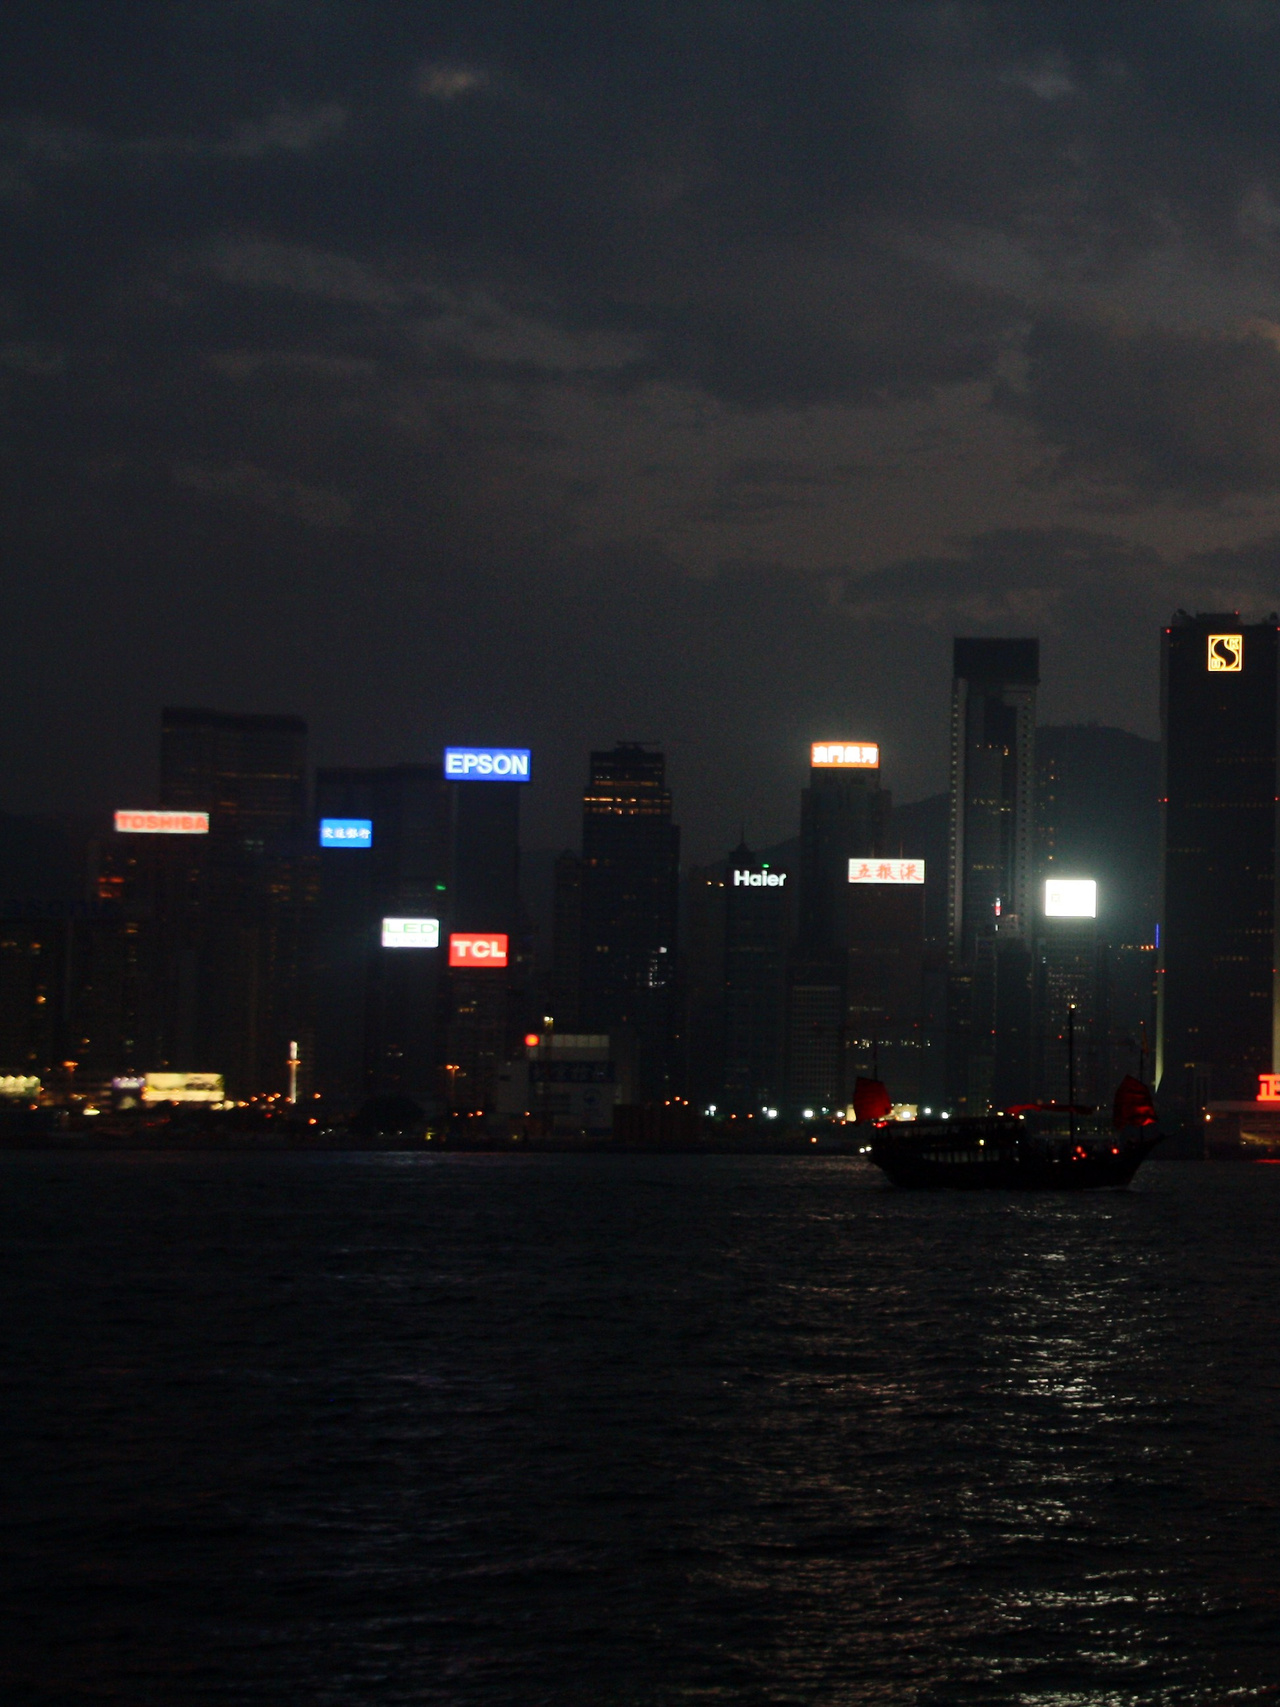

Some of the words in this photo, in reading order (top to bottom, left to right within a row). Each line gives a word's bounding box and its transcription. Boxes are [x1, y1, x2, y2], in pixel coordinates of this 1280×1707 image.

[445, 753, 528, 775] EPSON
[116, 814, 209, 830] TOSHIBA
[734, 869, 787, 887] Haier
[384, 922, 438, 934] LED
[452, 941, 507, 958] TCL
